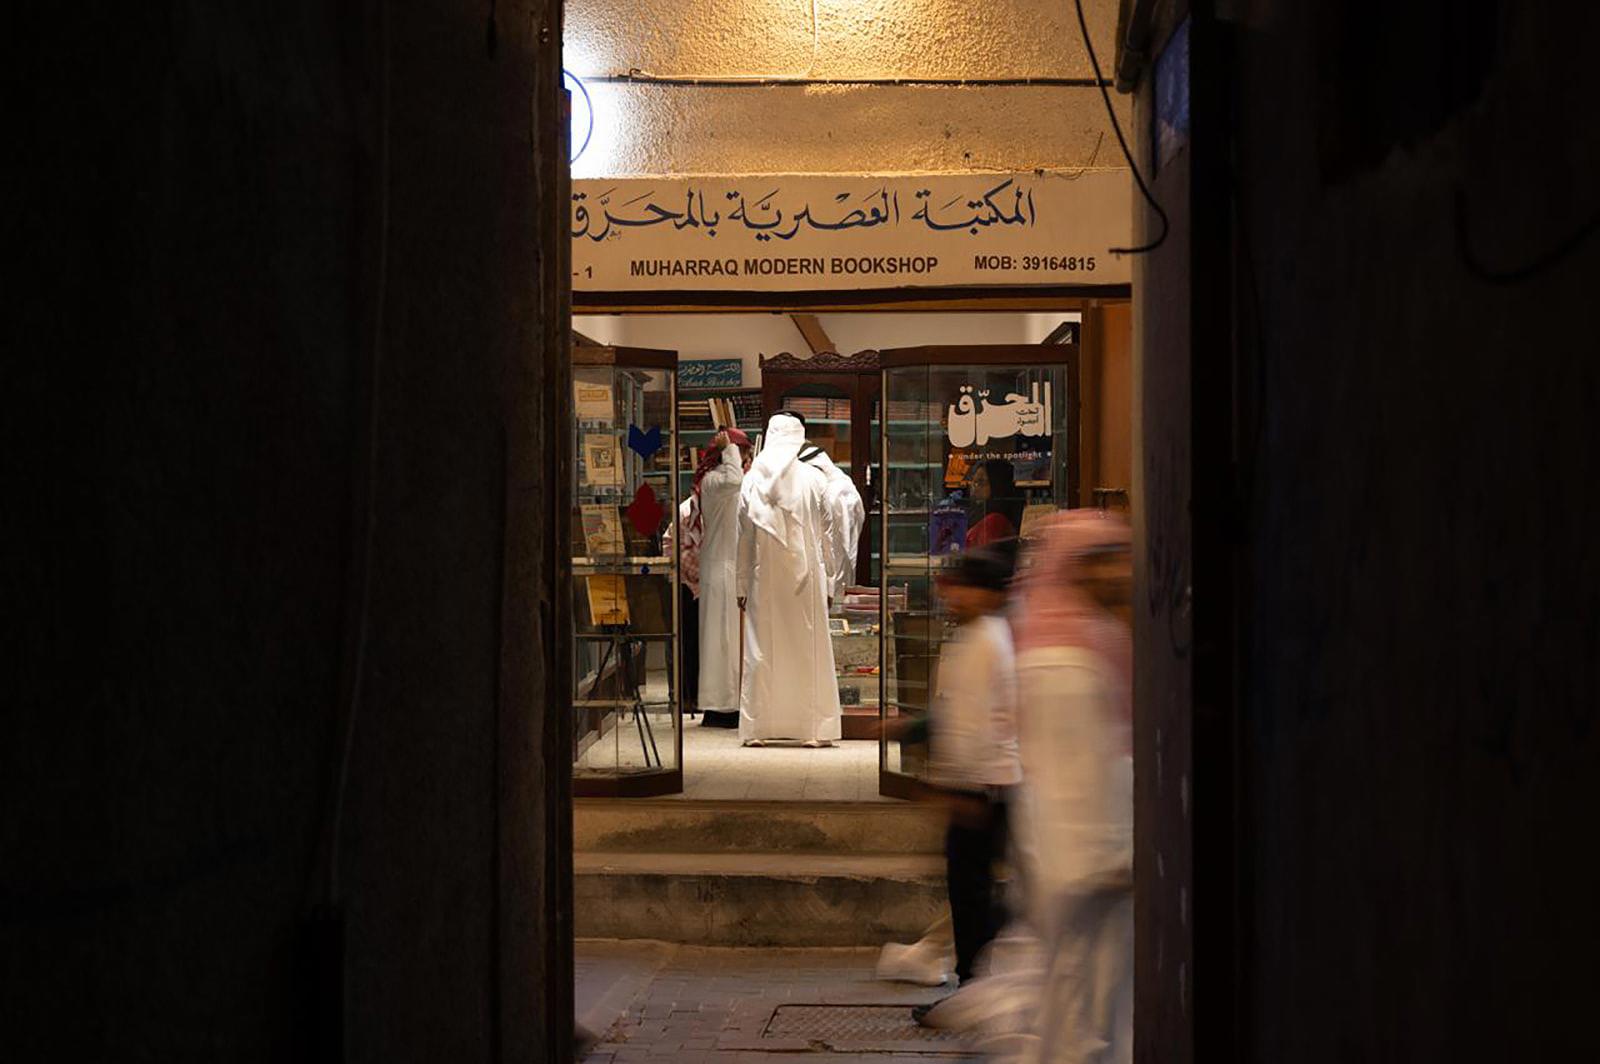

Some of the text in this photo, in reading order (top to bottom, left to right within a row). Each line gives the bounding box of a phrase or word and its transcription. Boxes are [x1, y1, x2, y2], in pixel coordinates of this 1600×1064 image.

[630, 256, 938, 277] MUHARRAQ MODERN BOOKSHOP
[974, 255, 1096, 271] MOB: 39164815
[585, 266, 593, 279] 1
[958, 452, 983, 460] under
[1004, 450, 1042, 461] spotlight
